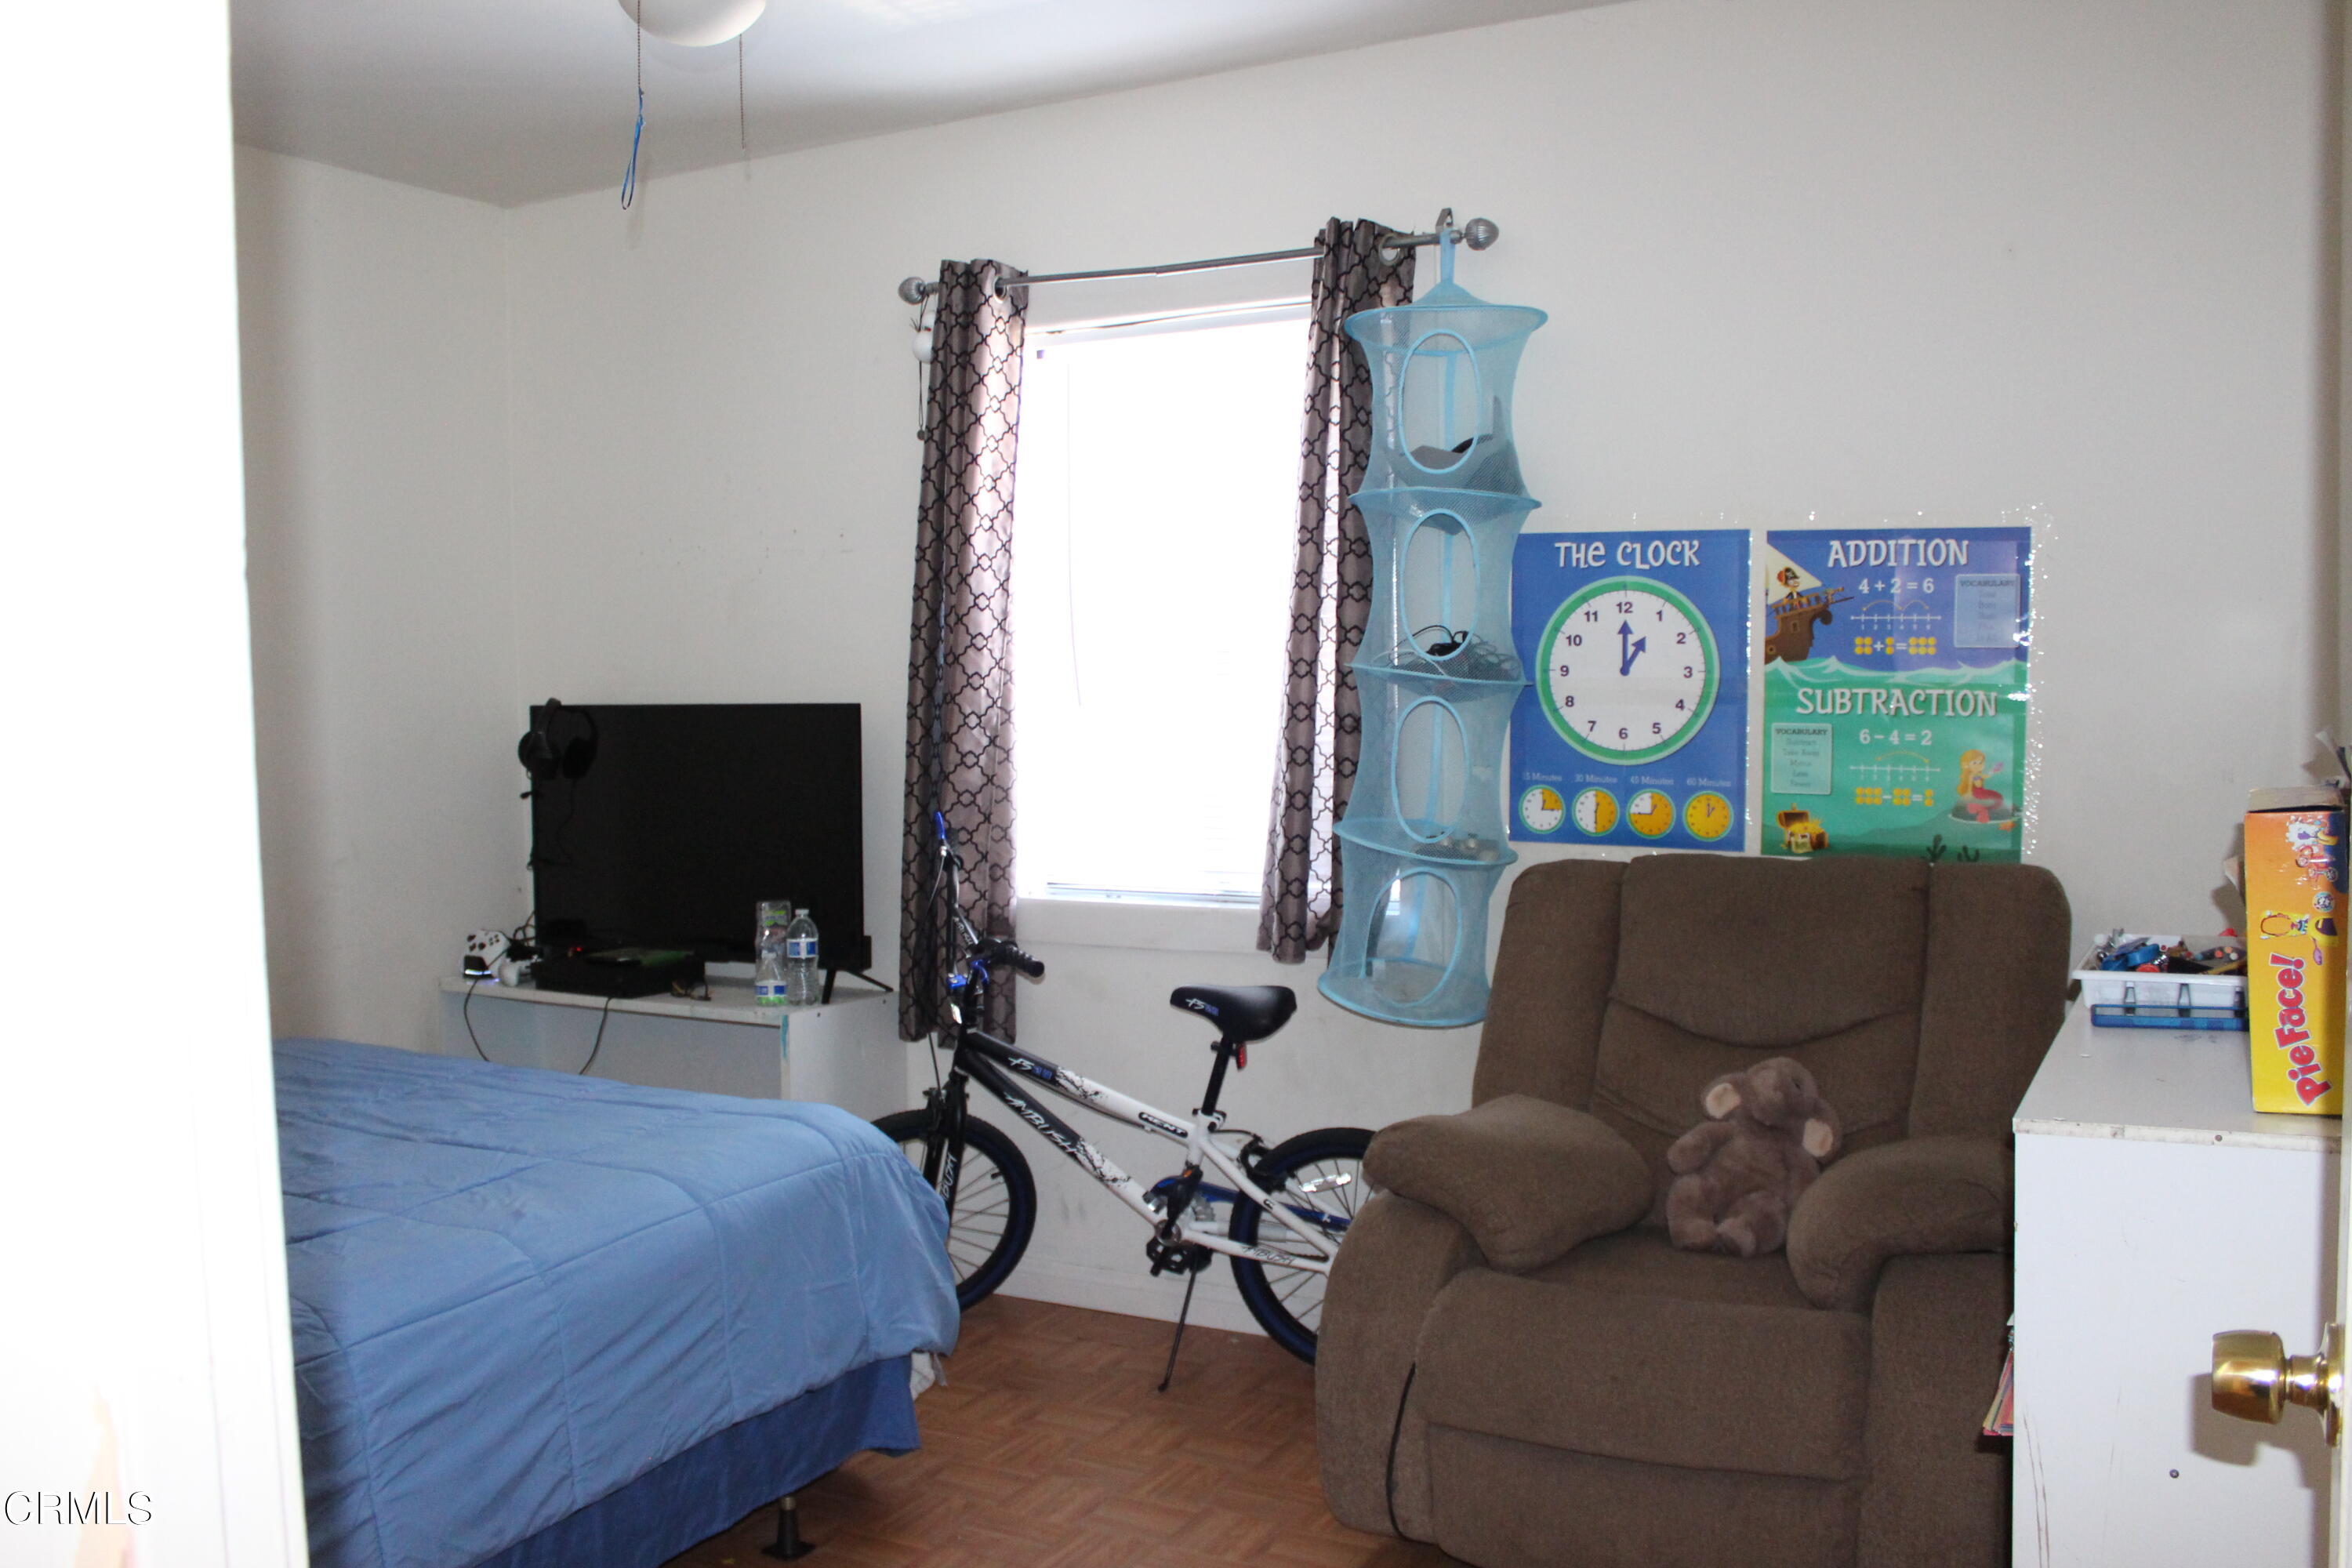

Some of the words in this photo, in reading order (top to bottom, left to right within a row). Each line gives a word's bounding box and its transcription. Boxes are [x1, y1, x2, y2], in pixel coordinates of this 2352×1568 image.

[1616, 539, 1700, 570] CLOCK
[1827, 538, 1970, 568] ADDITION
[1858, 578, 1870, 594] 4
[1890, 578, 1902, 593] 2
[1922, 577, 1935, 593] 6
[1615, 601, 1633, 614] 12
[1584, 610, 1599, 622] 11
[1656, 610, 1663, 622] 1
[1565, 634, 1583, 647] 10
[1676, 632, 1686, 644] 2
[1559, 665, 1570, 677] 9
[1682, 666, 1693, 678] 3
[1565, 695, 1575, 708] 8
[1675, 699, 1685, 711] 4
[1795, 687, 1998, 717] SUBTRACTION
[1587, 720, 1596, 732] 7
[1651, 722, 1661, 735] 5
[1618, 728, 1628, 739] 6
[1859, 728, 1871, 745] 6
[1889, 729, 1900, 745] 4
[1920, 729, 1933, 746] 2
[1586, 774, 1618, 783] Minutes
[1642, 775, 1675, 786] Minutes
[1004, 1092, 1077, 1154] AMBUSH
